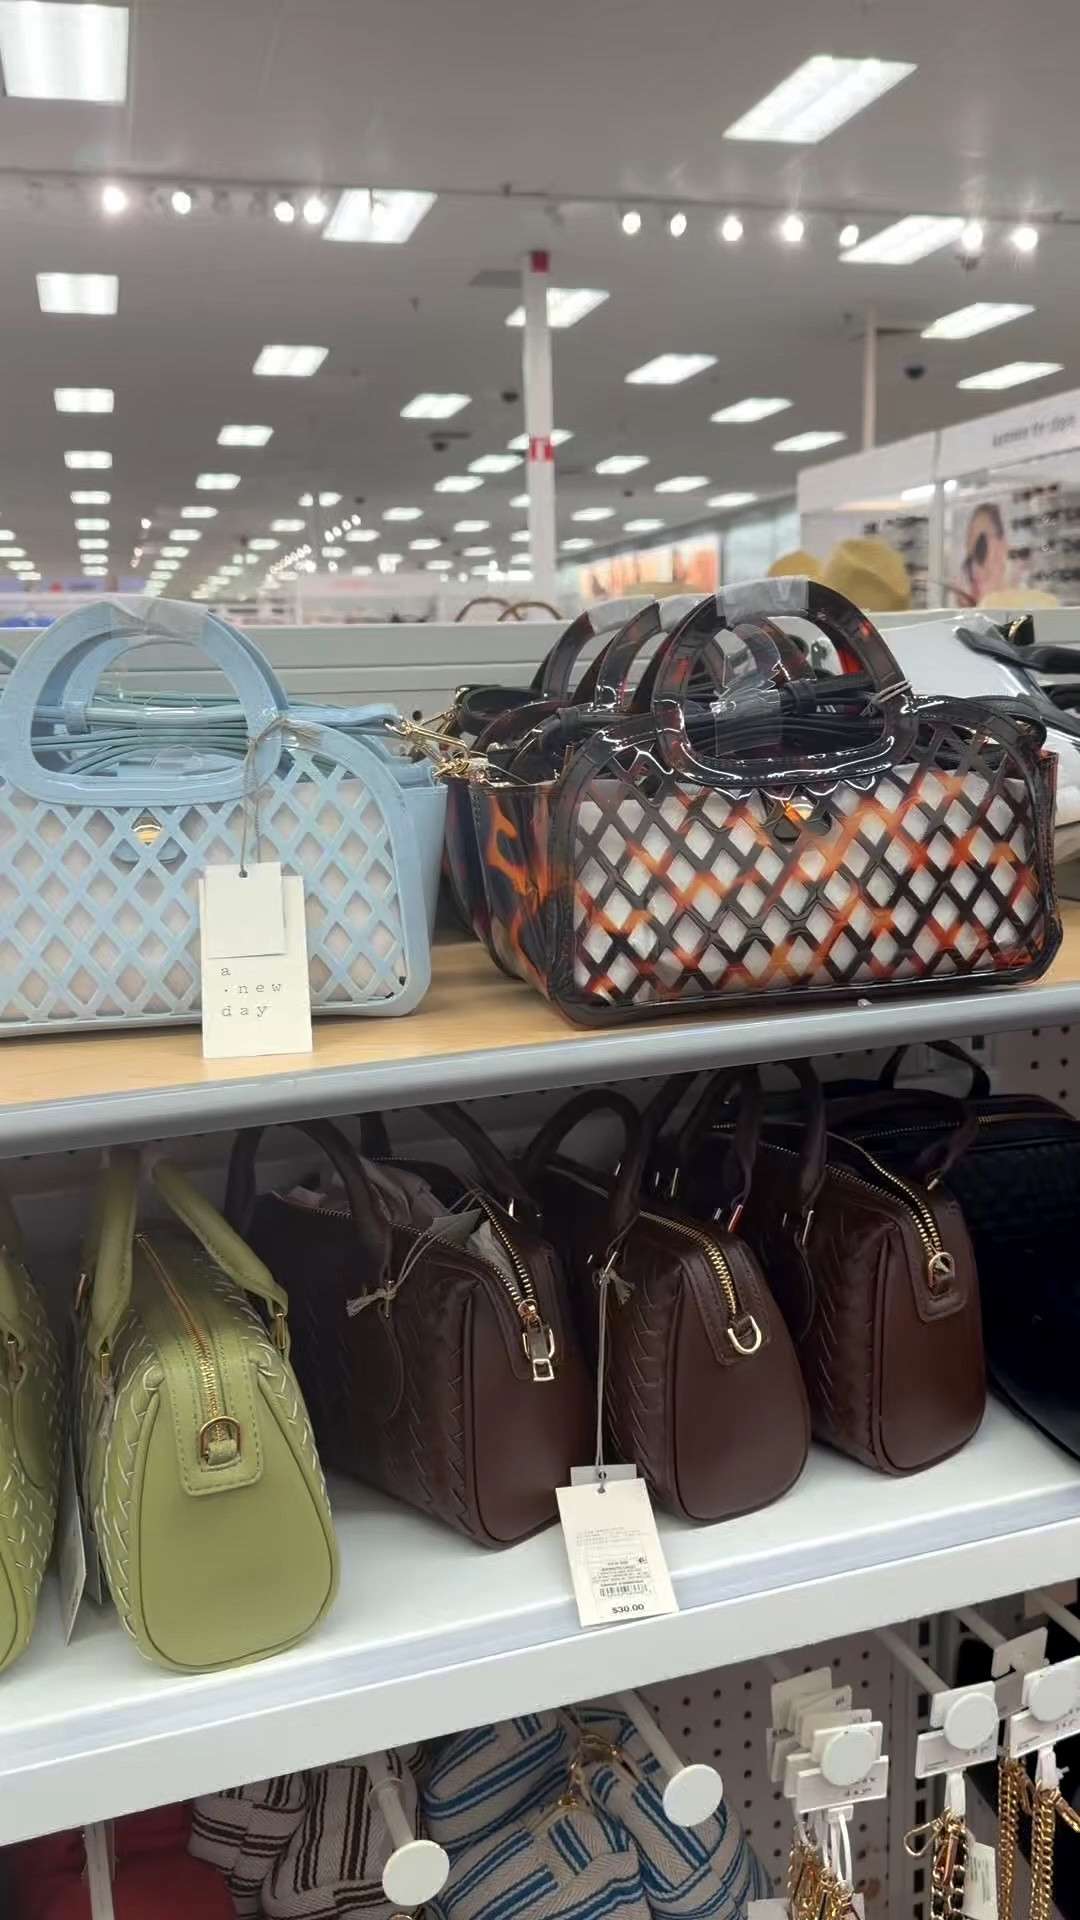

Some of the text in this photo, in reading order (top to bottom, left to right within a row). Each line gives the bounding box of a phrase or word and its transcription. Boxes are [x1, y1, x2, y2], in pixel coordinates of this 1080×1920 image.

[220, 967, 231, 976] a
[222, 1005, 267, 1017] day
[611, 1603, 645, 1614] $30.00
